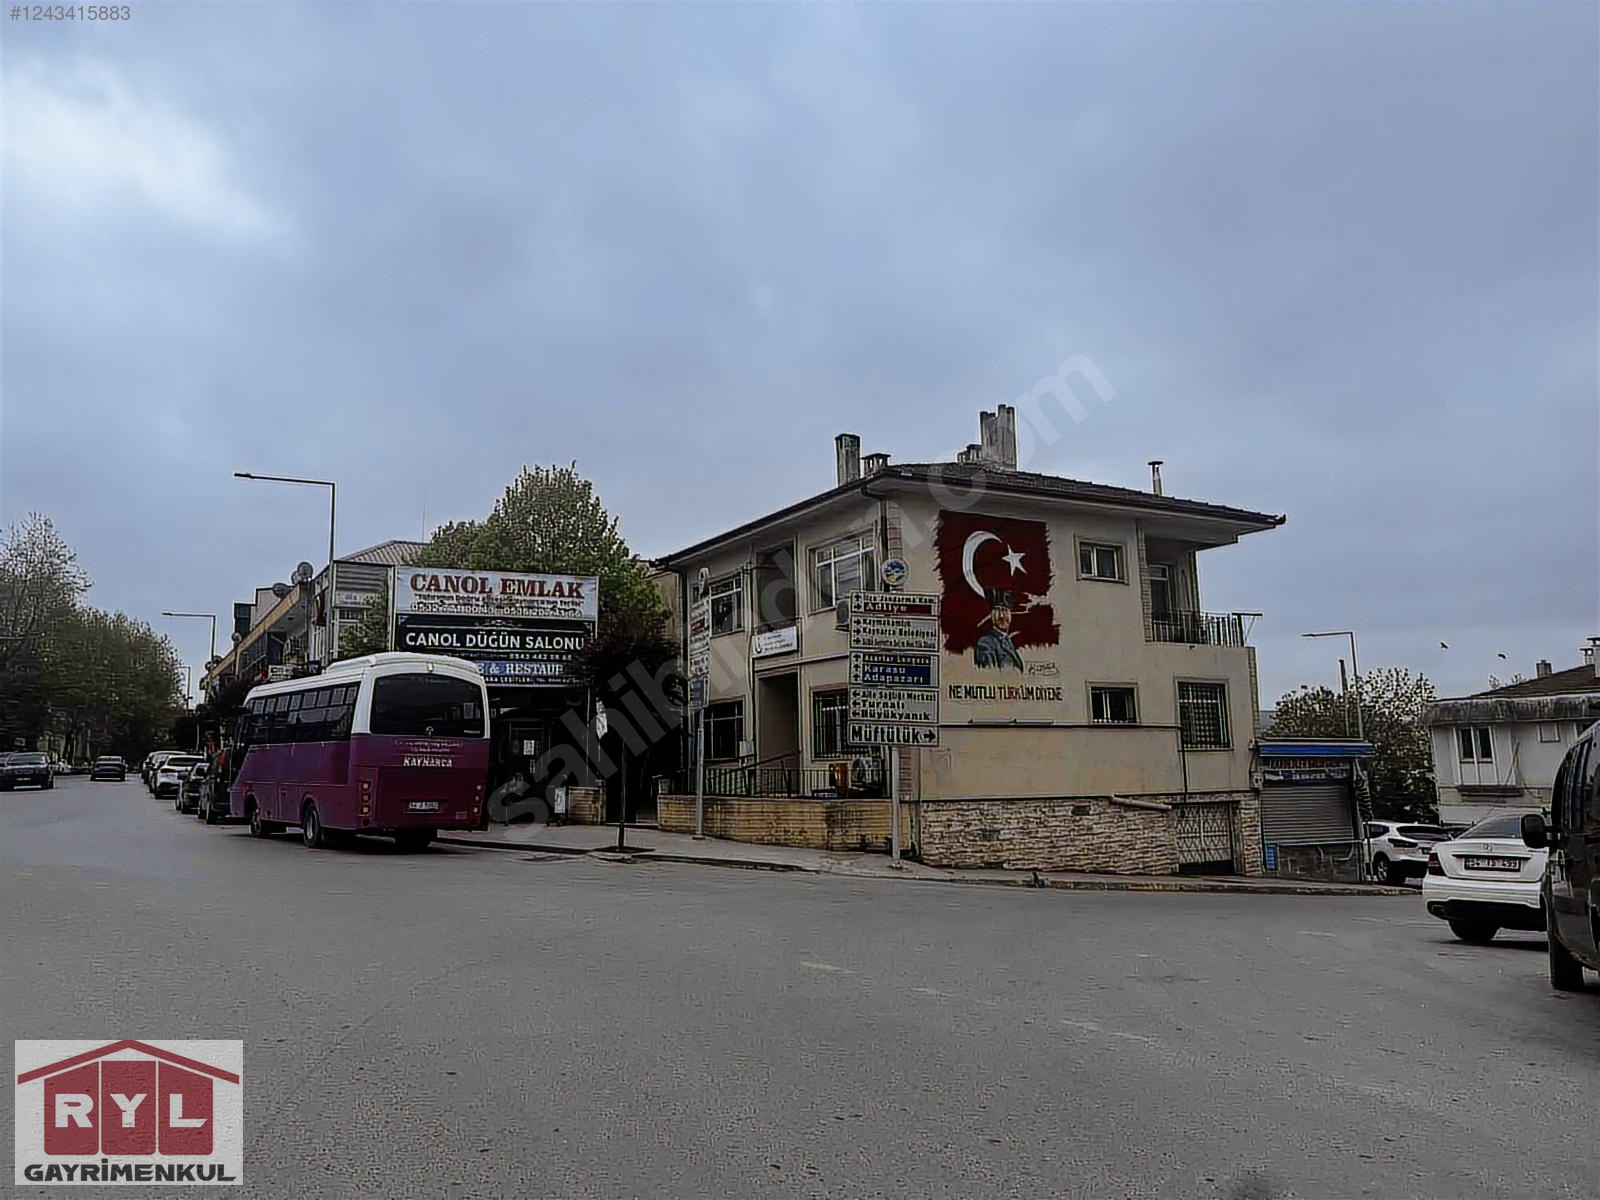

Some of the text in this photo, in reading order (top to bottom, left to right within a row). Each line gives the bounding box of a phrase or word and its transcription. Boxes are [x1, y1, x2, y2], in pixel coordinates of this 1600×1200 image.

[410, 573, 585, 599] CANOL EMLAK
[865, 603, 908, 614] Adliye
[406, 631, 585, 650] CANOL DÜĞÜN SALONU
[505, 662, 563, 675] RESTAUR
[864, 665, 905, 674] Karasu
[864, 674, 923, 683] Adapazarı
[948, 685, 962, 699] NE
[963, 685, 996, 699] MUTLU
[861, 700, 904, 709] Turnalı
[861, 709, 930, 720] Büyükyanık
[851, 723, 920, 744] Müftülük
